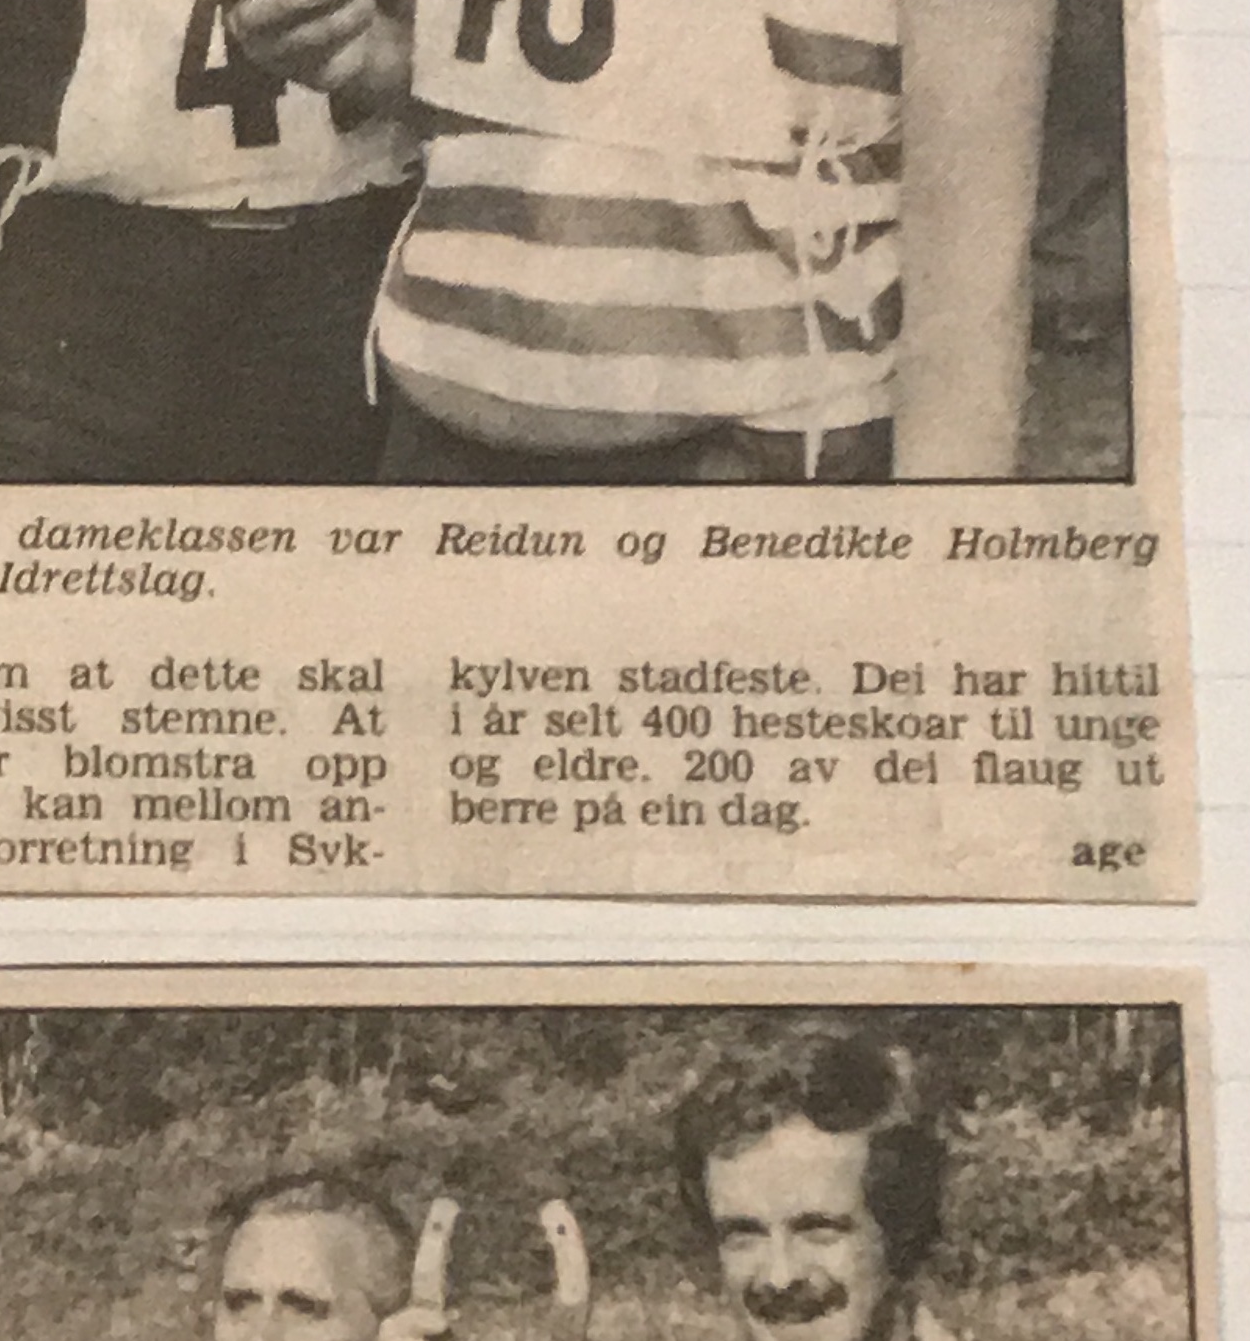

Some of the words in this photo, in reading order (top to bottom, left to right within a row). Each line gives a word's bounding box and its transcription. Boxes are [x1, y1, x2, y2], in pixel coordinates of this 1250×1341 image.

[18, 516, 296, 549] dameklassen
[330, 528, 403, 552] var
[435, 523, 585, 553] Reidun
[617, 532, 666, 564] og
[700, 525, 912, 557] Benedikte
[946, 525, 1159, 567] Holmberg
[70, 659, 114, 689] at
[150, 656, 260, 690] dette
[298, 658, 384, 691] skal
[450, 657, 590, 698] kylven
[618, 660, 820, 693] stadfeste.
[853, 662, 925, 694] Dei
[953, 662, 1027, 695] har
[1052, 662, 1159, 696] hittil
[451, 702, 462, 735] i
[483, 703, 527, 736] år
[545, 702, 622, 736] selt
[642, 705, 711, 737] 400
[733, 705, 968, 739] hesteskoar
[990, 706, 1033, 740] til
[1055, 715, 1160, 749] unge
[64, 744, 255, 778] blomstra
[306, 754, 387, 788] opp
[450, 790, 558, 824] berre
[574, 792, 626, 833] på
[640, 794, 706, 825] ein
[719, 793, 810, 835] dag.
[1071, 840, 1147, 873] age
